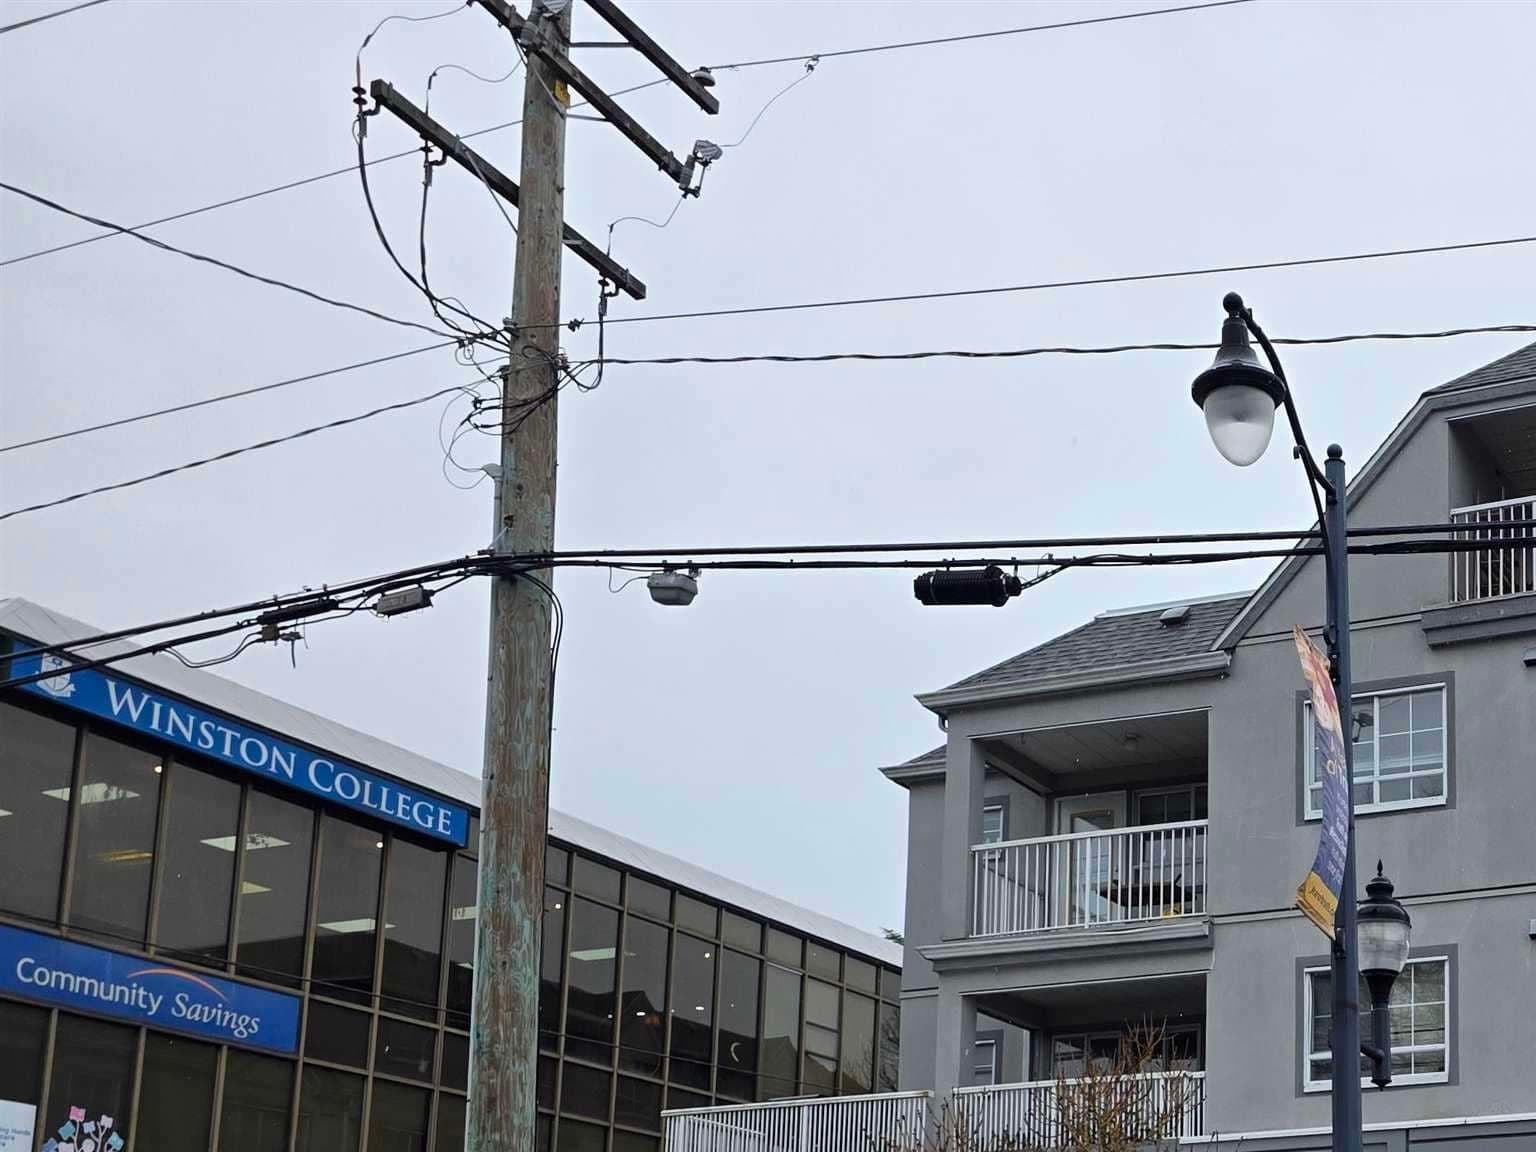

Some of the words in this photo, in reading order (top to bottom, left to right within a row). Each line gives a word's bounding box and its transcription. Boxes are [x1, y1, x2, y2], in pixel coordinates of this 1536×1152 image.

[106, 680, 296, 778] WINSTON
[308, 758, 452, 835] COLLEGE
[16, 958, 163, 1015] Community
[171, 993, 260, 1038] Savings
